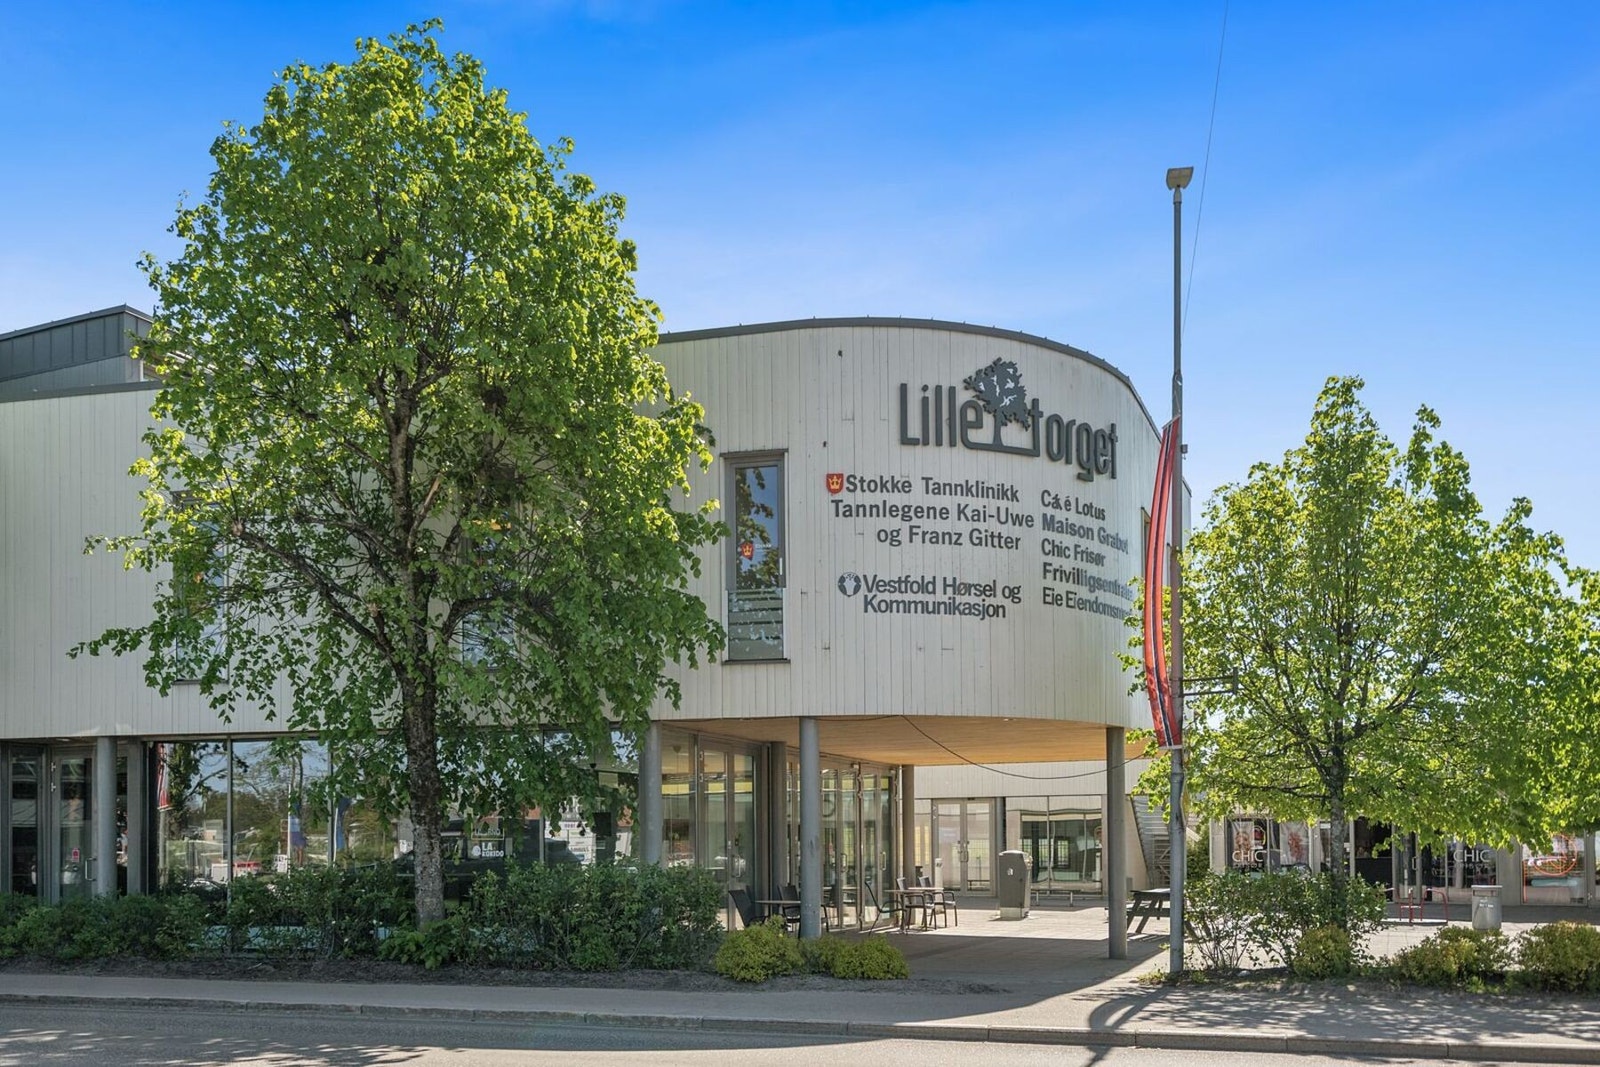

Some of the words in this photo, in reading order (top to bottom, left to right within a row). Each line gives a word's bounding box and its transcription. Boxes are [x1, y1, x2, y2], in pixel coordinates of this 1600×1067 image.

[846, 474, 912, 493] Stokke
[921, 477, 1019, 502] Tannklinikk
[831, 499, 950, 522] Tannlegene
[957, 503, 1034, 528] Kai-Uwe
[1075, 497, 1106, 521] Lotus
[877, 529, 902, 547] og
[909, 525, 963, 546] Franz
[969, 528, 1021, 550] Gitter
[1042, 513, 1095, 541] Maison
[1041, 538, 1071, 559] Chic
[1074, 544, 1106, 567] Frisør
[863, 574, 936, 595] Vestfold
[943, 576, 997, 599] Hørsel
[1002, 584, 1022, 604] og
[1043, 587, 1064, 607] Eie
[863, 594, 1006, 620] Kommunikasjon
[1232, 850, 1267, 862] CHIC
[1453, 850, 1490, 862] CHIC
